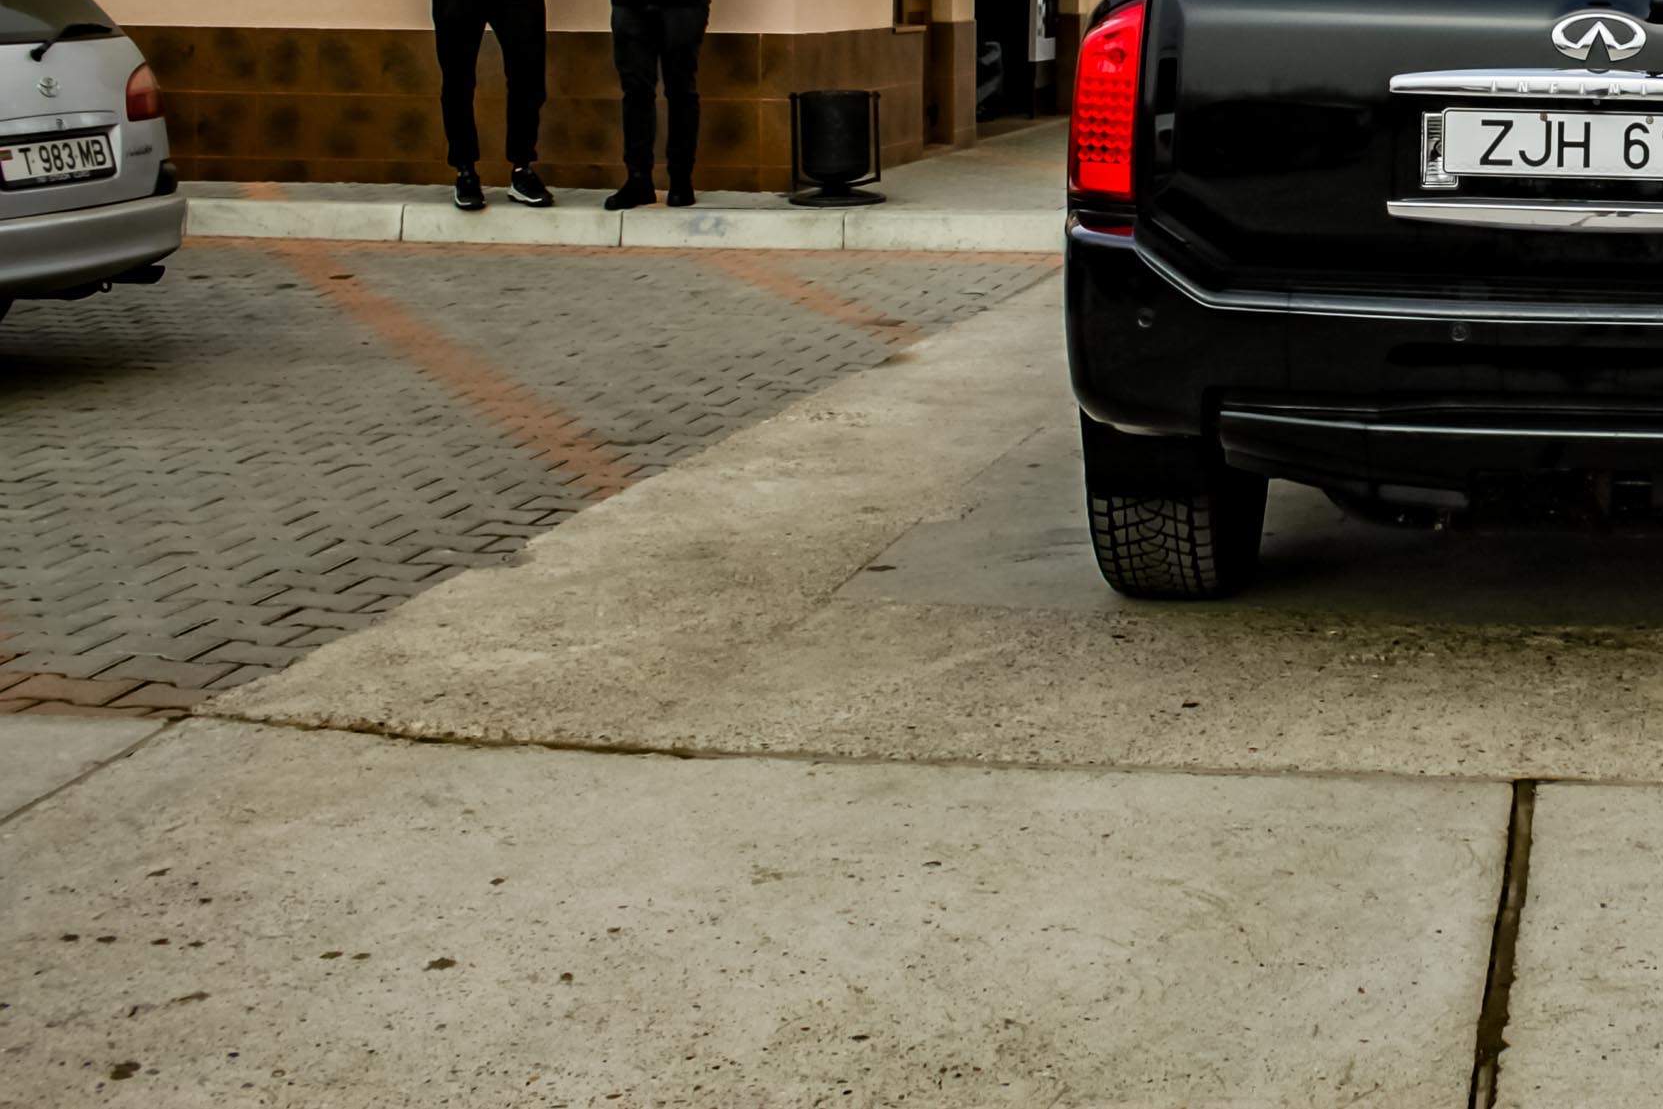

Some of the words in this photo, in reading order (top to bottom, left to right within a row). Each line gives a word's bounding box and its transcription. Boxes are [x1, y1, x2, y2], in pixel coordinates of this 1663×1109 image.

[18, 147, 32, 176] T
[38, 142, 76, 173] 983
[77, 138, 107, 168] MB
[1479, 118, 1591, 168] ZJH
